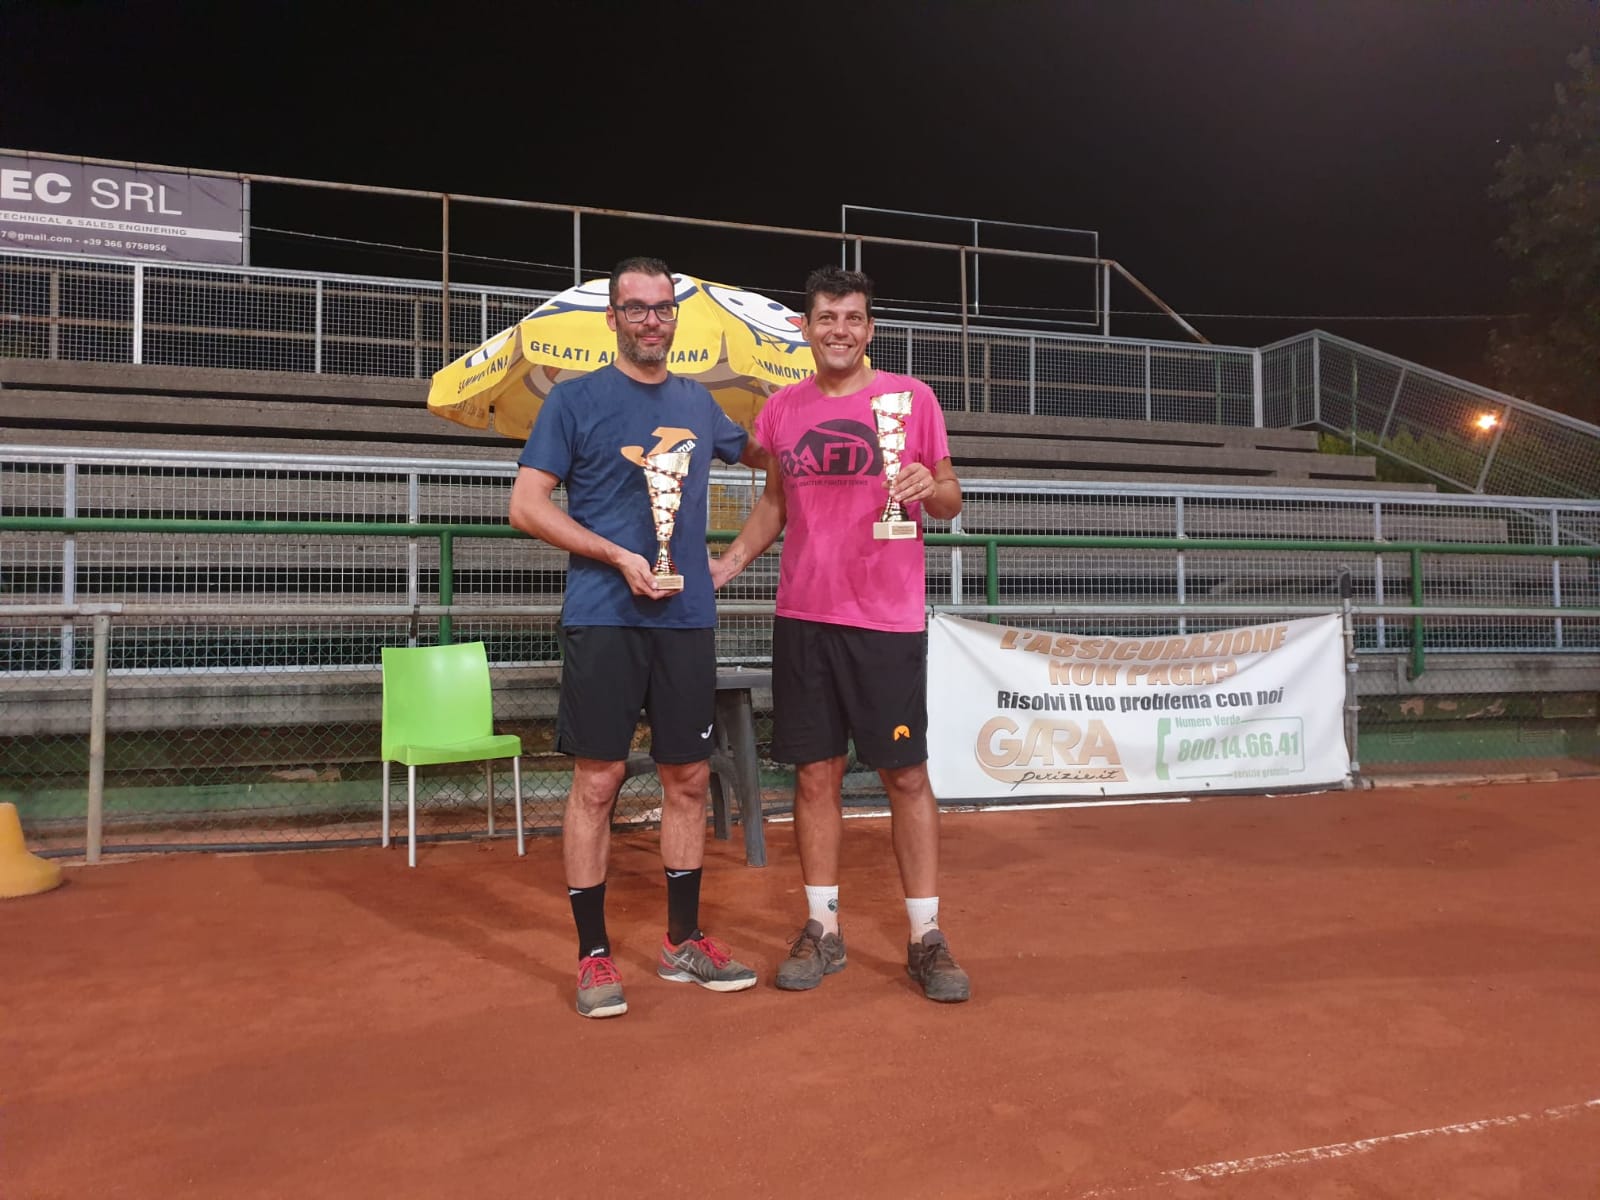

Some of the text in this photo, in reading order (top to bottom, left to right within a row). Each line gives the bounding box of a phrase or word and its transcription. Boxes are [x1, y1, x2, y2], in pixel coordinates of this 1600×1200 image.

[0, 168, 182, 216] EC SRL
[78, 219, 114, 230] SALES
[118, 223, 187, 236] ENGINERING
[530, 340, 590, 362] GELATI
[1000, 626, 1288, 661] L'ASSICURAZIONE
[1048, 660, 1122, 686] NON
[997, 686, 1285, 713] Risolvi il tuo problema con noi
[1175, 714, 1241, 729] Numero Verde
[976, 716, 1123, 767] GARA
[1177, 731, 1299, 763] 800.14.66.41
